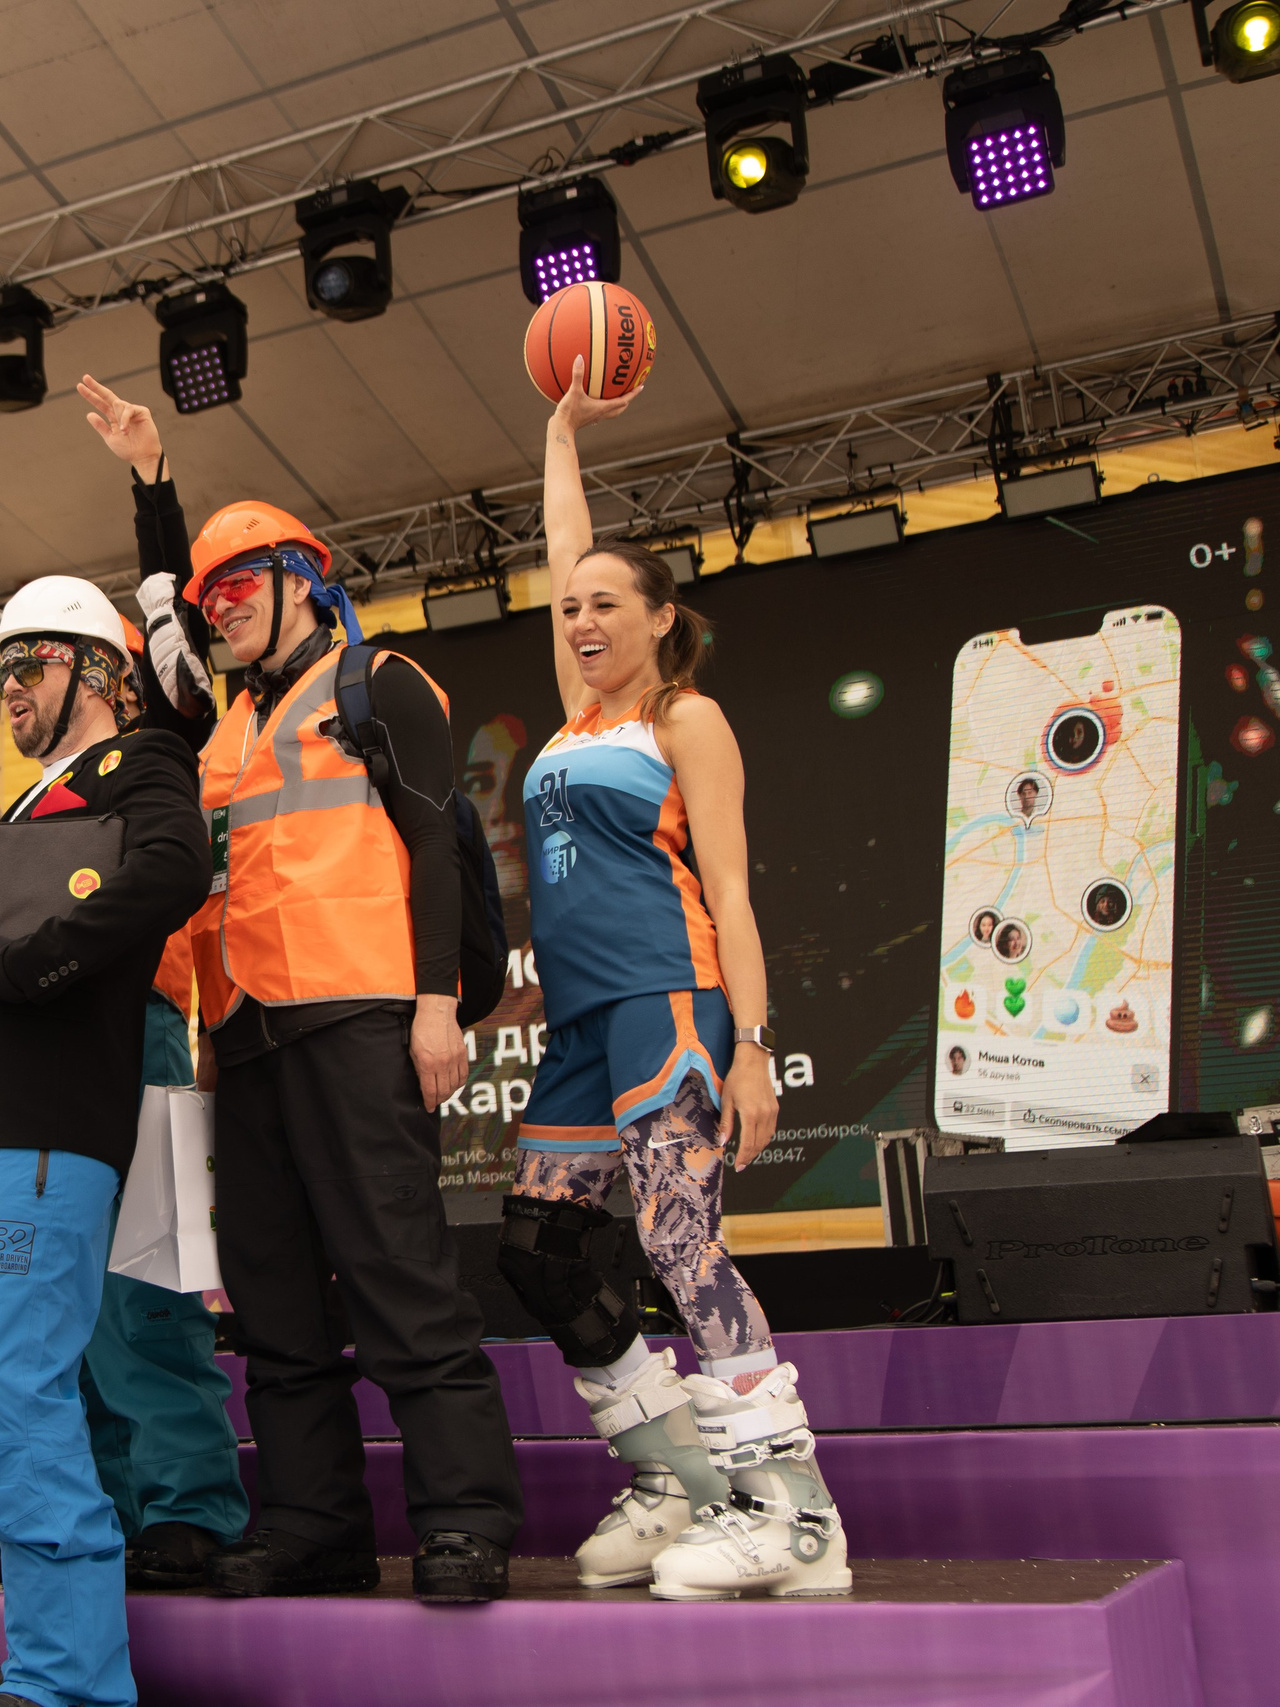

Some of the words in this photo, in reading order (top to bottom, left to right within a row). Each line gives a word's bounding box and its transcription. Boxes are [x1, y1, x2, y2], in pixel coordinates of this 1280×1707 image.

[611, 304, 635, 386] molten
[1189, 543, 1237, 568] 0+
[539, 766, 575, 827] 21
[978, 1051, 1010, 1064] Миша
[1012, 1052, 1045, 1068] Котов
[1038, 1114, 1102, 1132] Скопировать
[469, 1168, 516, 1185] Маркс
[985, 1234, 1210, 1261] ProTone
[6, 1254, 29, 1264] DRIVEN
